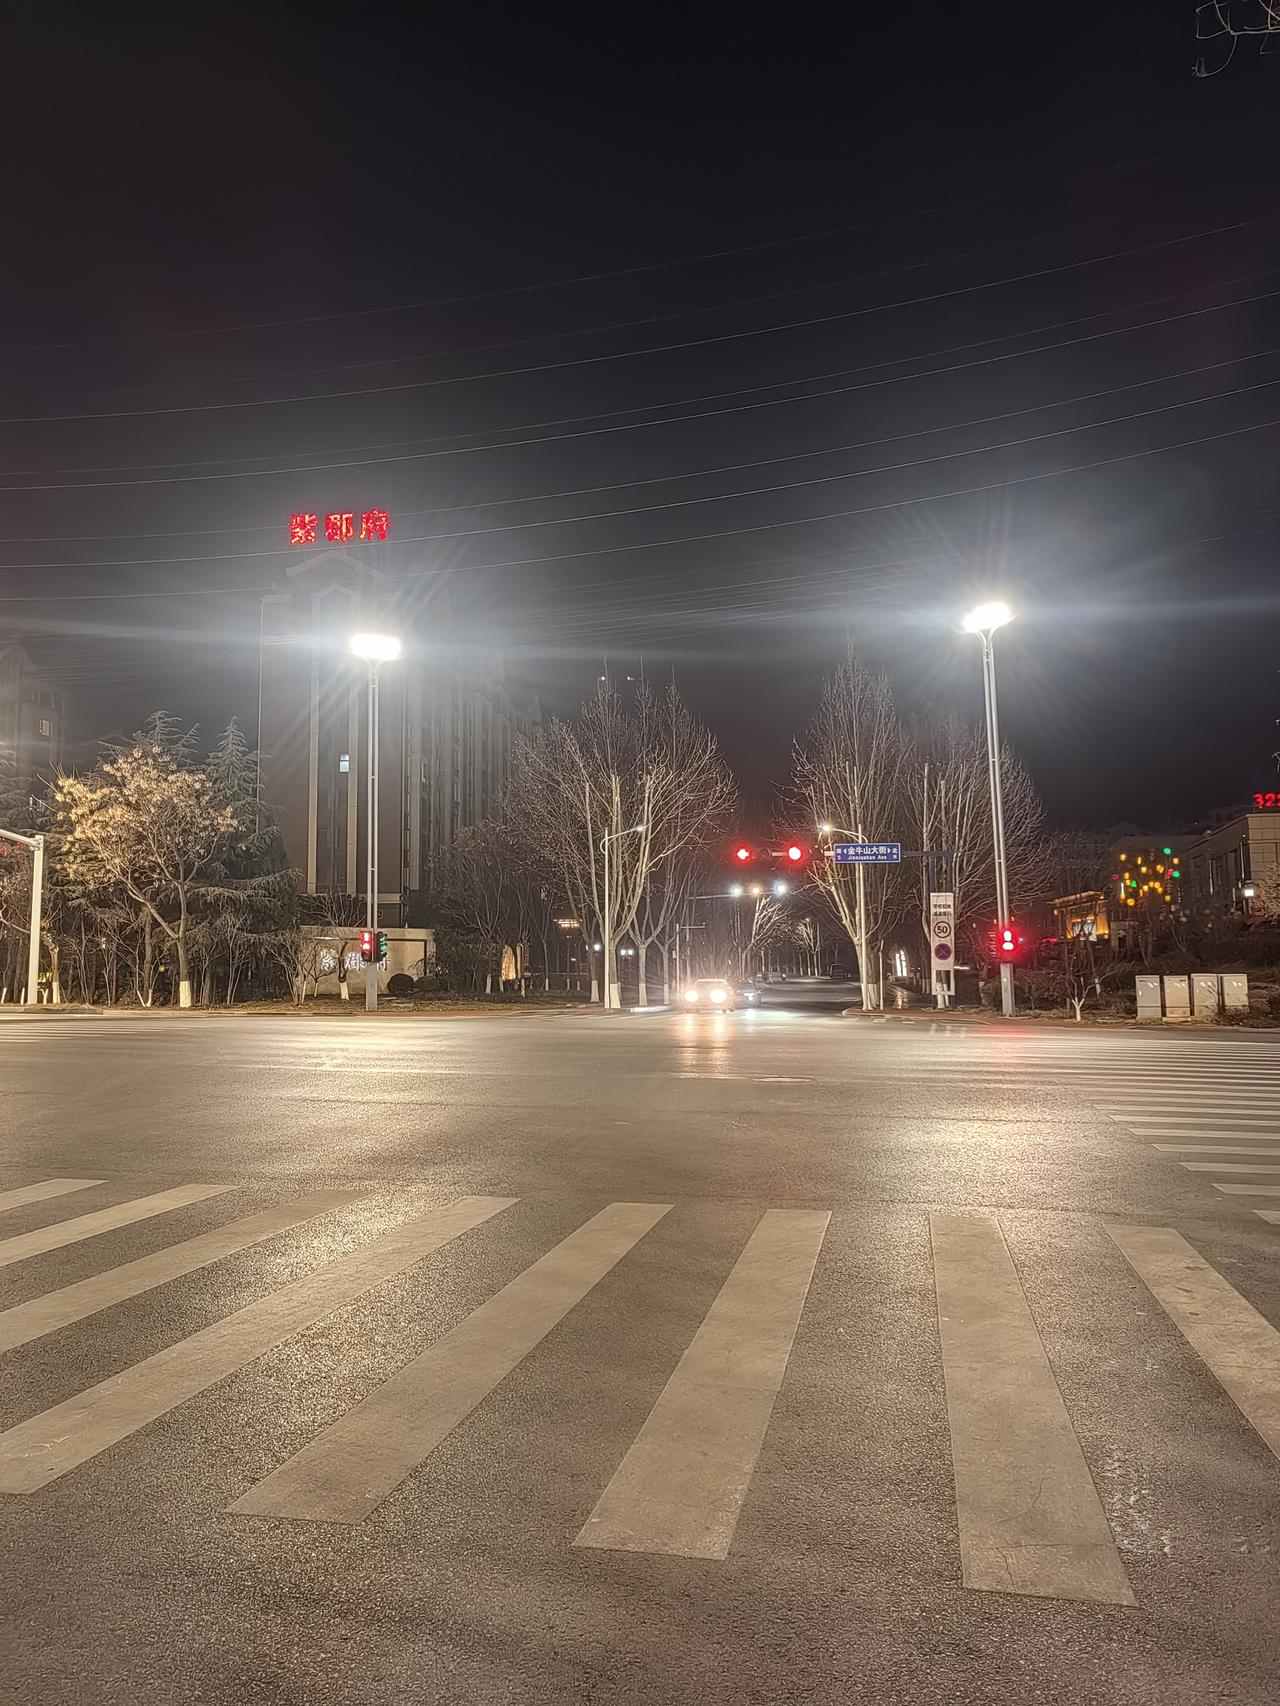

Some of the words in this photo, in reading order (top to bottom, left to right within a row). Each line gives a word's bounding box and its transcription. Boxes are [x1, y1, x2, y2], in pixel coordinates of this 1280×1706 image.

[1252, 792, 1280, 808] 32
[847, 846, 887, 855] 金牛山大街
[937, 925, 948, 934] 50
